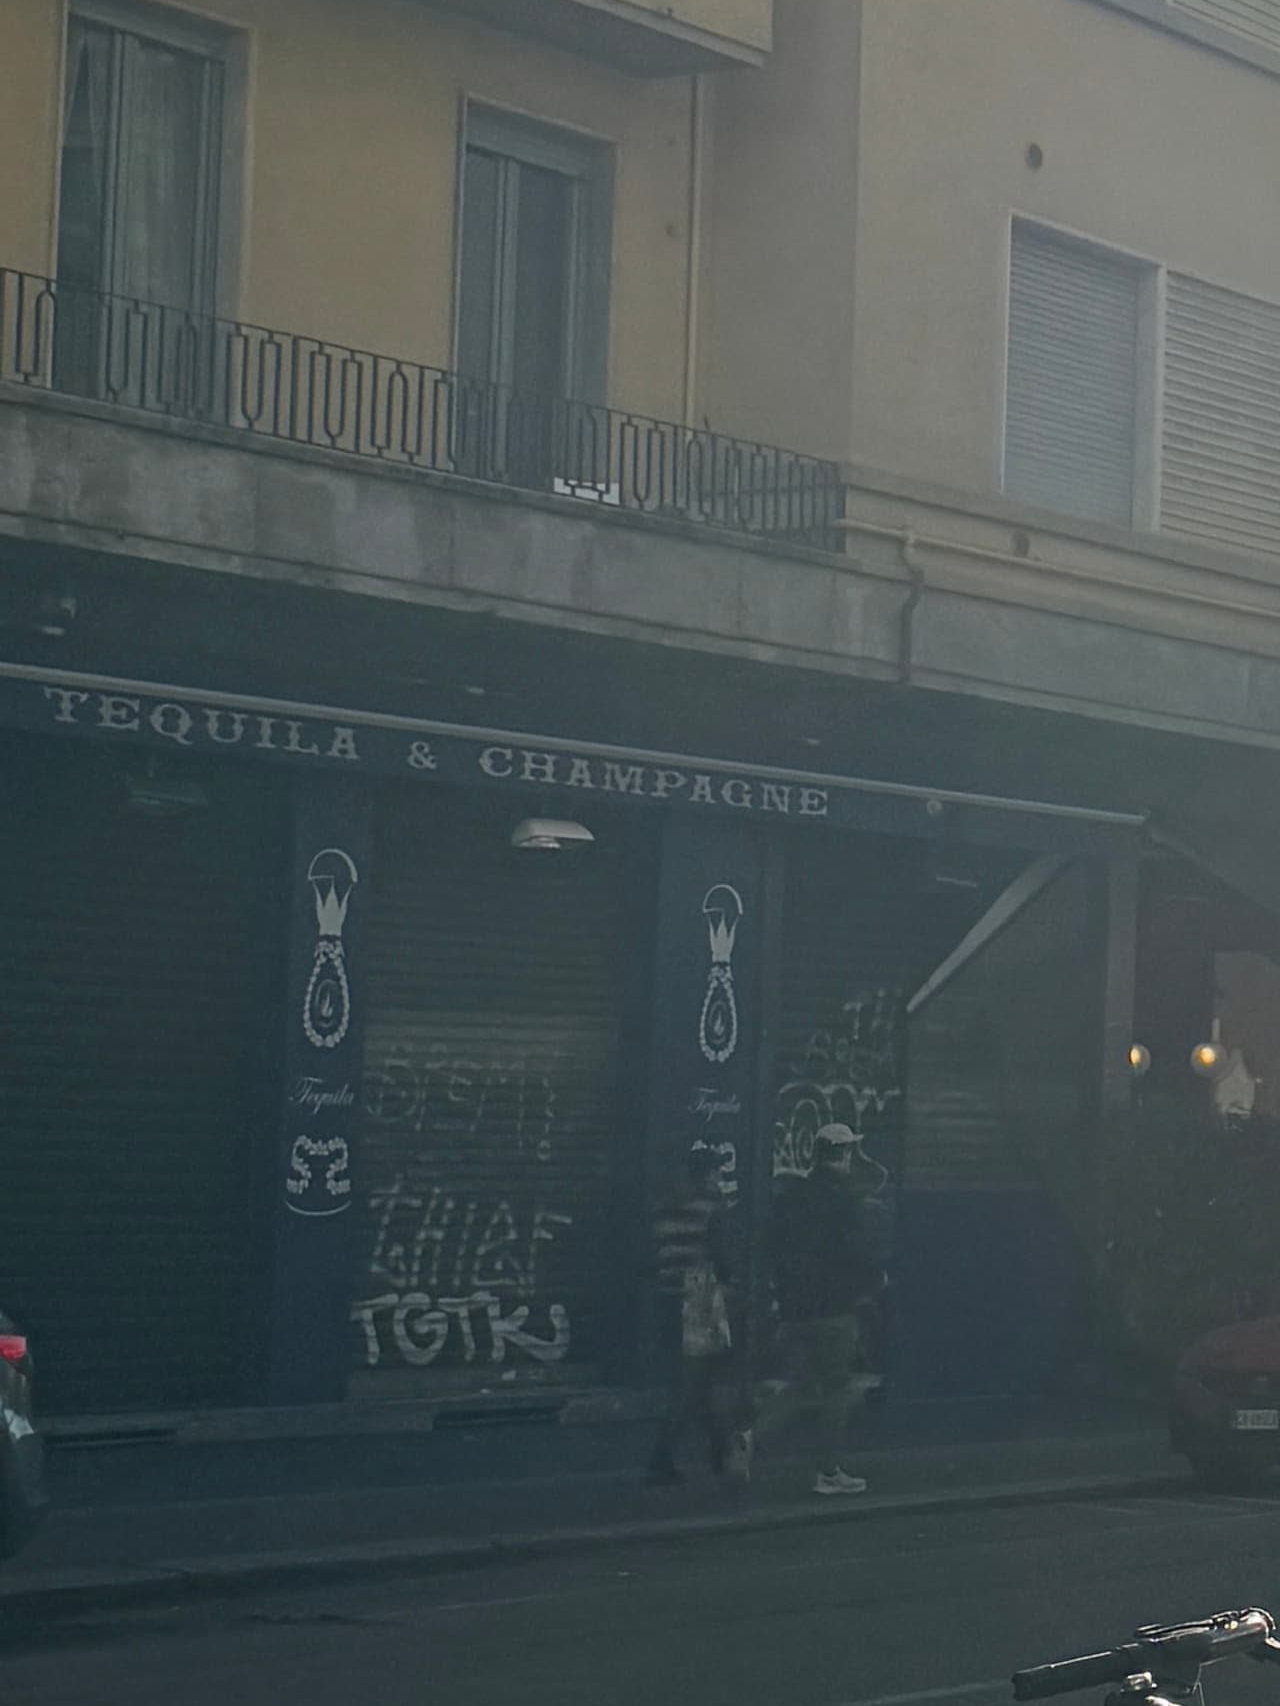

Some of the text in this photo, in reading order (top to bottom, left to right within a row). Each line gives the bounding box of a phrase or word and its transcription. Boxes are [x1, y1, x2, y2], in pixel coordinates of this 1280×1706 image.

[42, 687, 830, 816] TEQUILA & CHAMPAGNE
[287, 1076, 355, 1117] Tequila
